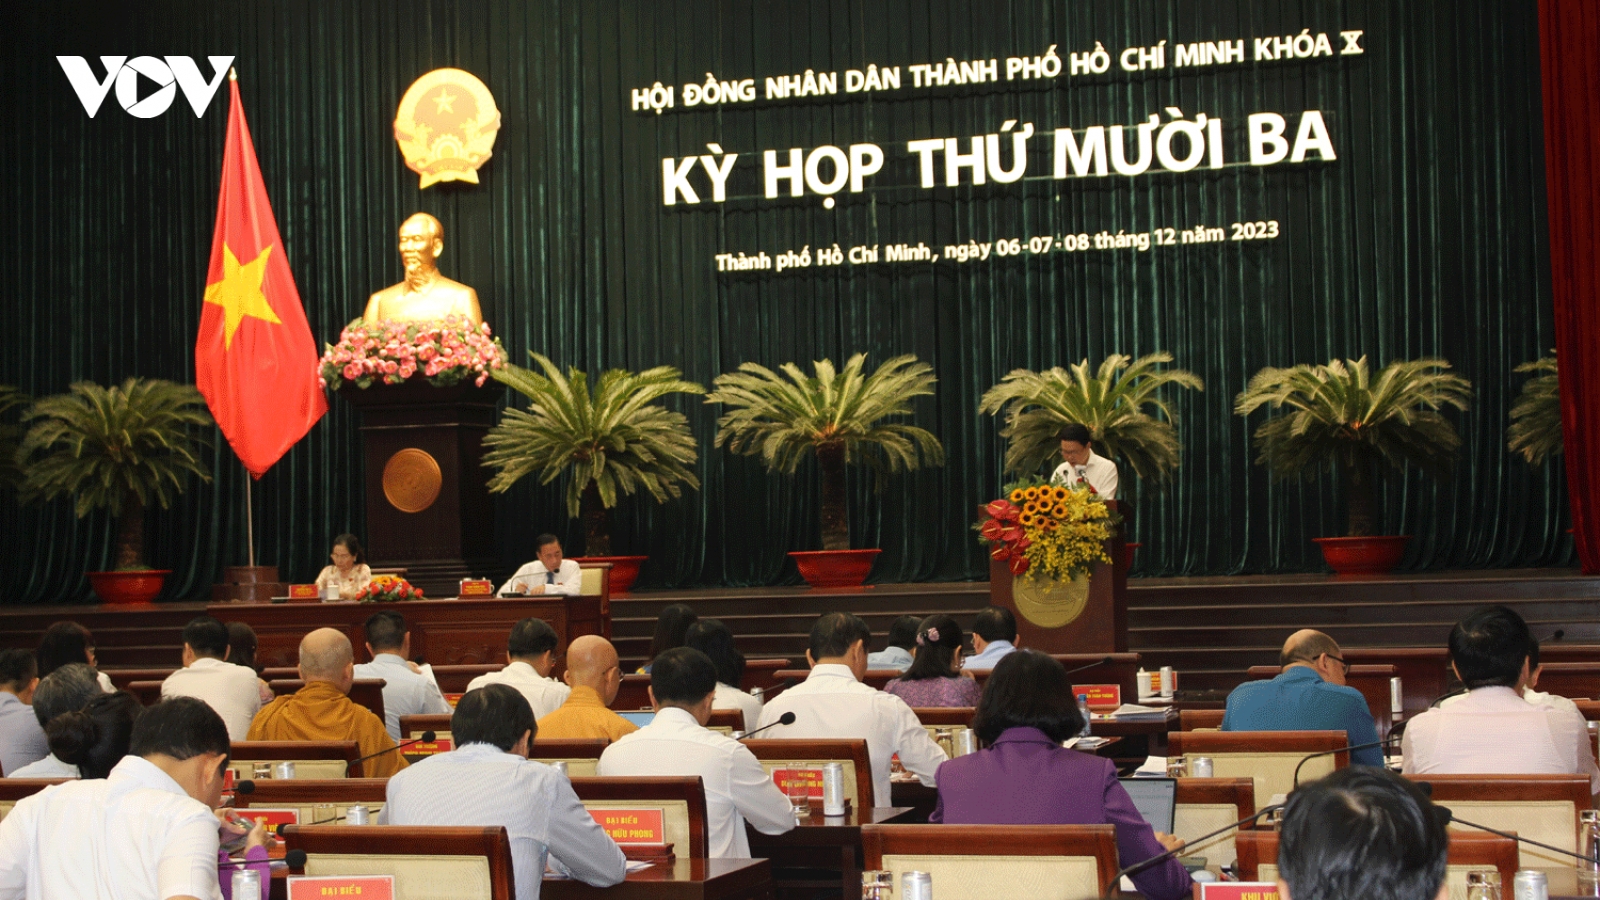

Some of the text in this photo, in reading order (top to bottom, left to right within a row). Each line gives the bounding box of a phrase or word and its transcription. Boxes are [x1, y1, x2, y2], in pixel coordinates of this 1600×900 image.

[632, 28, 1364, 114] HỘI ĐỒNG NHÂN DÂN THÀNH PHỐ HỒ CHÍ MINH KHÓA X
[662, 106, 1337, 209] KỲ HỌP THỨ MƯỜI BA
[715, 220, 1279, 272] Thành phố Hồ Chí Minh, ngày 06-07-08 tháng 12 năm 2023
